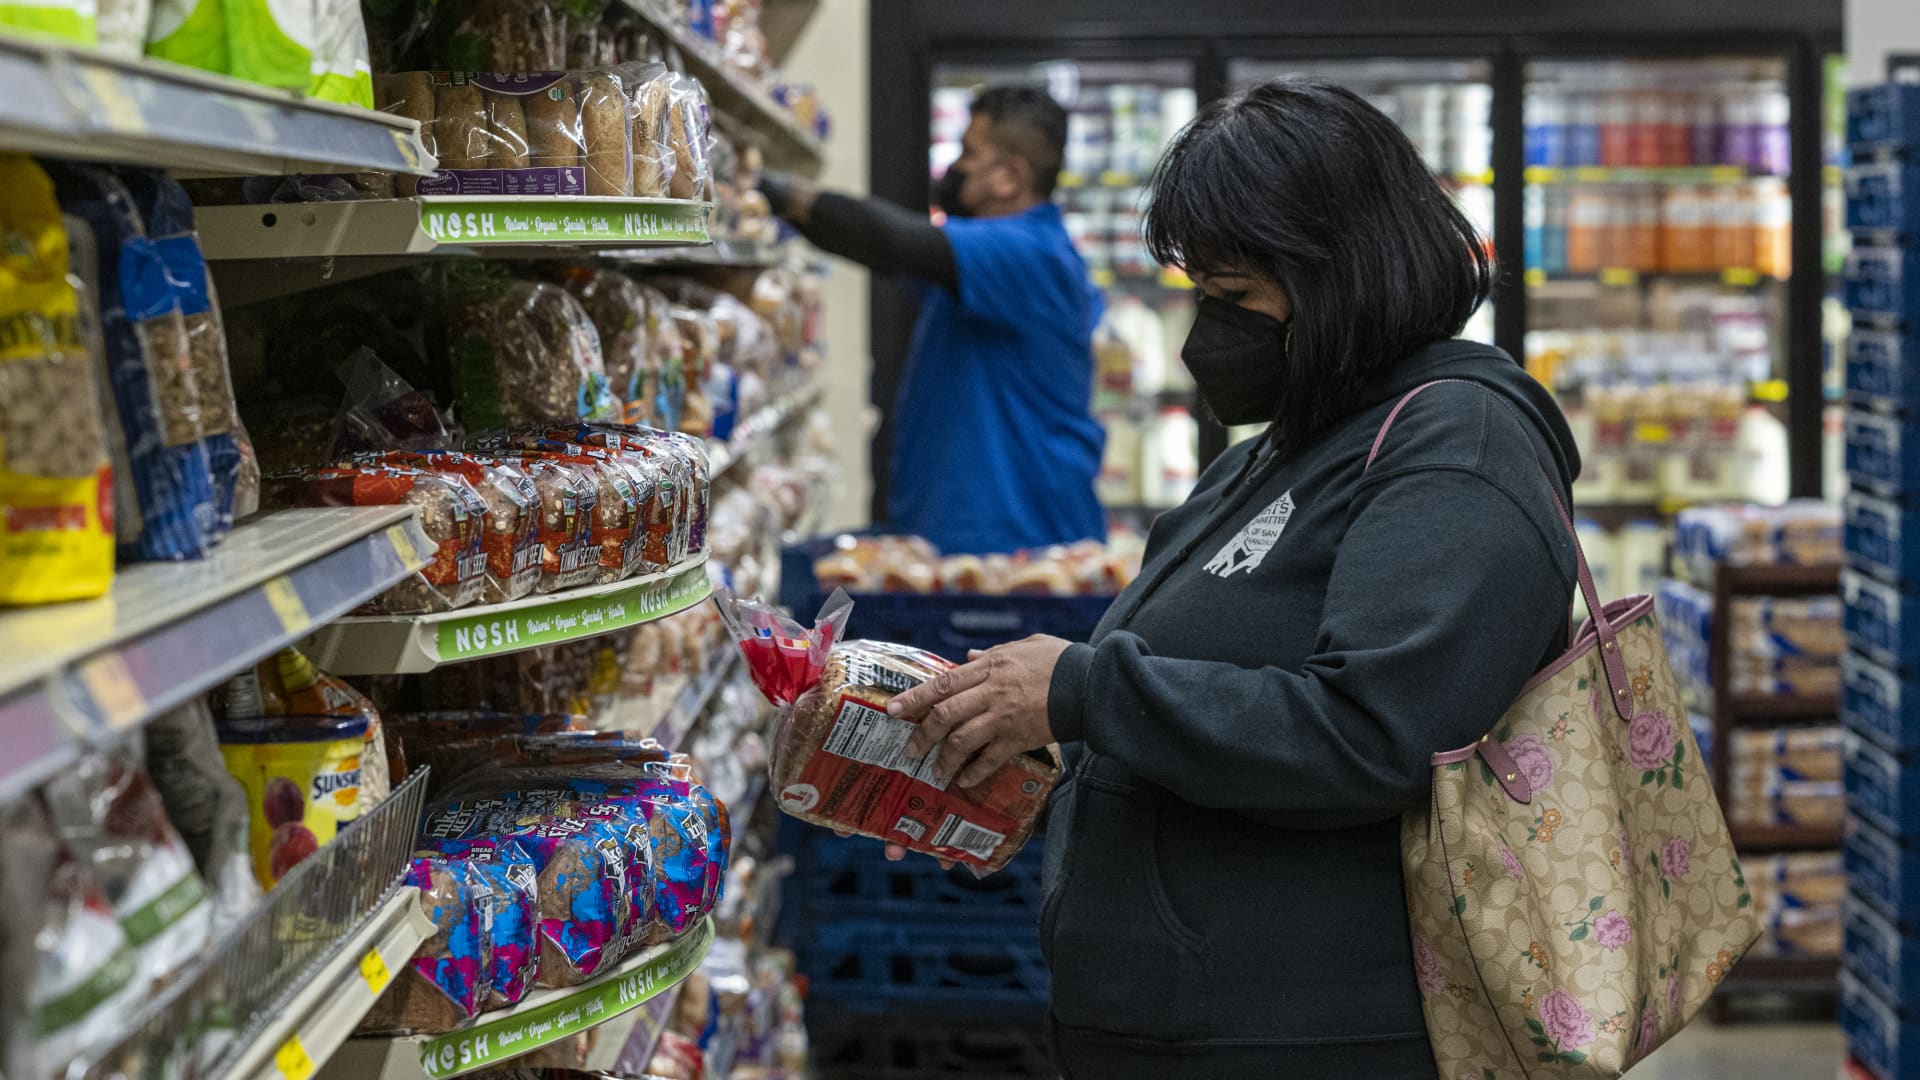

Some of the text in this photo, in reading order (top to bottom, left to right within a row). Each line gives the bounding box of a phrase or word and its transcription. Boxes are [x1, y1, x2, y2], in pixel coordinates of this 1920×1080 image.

[430, 213, 609, 239] NOSH Natural Organic Specialty Healthy
[624, 212, 658, 236] NOSH
[1261, 529, 1278, 538] SAN
[640, 588, 669, 615] NOSH
[456, 602, 626, 653] NOSH Natural Organic Specialty Healthy
[824, 705, 851, 751] Nutrition Facts
[847, 710, 875, 758] Calories 100
[619, 967, 654, 1005] NOSH
[423, 996, 604, 1075] NOSH Natural Organic Specialty Healthy
